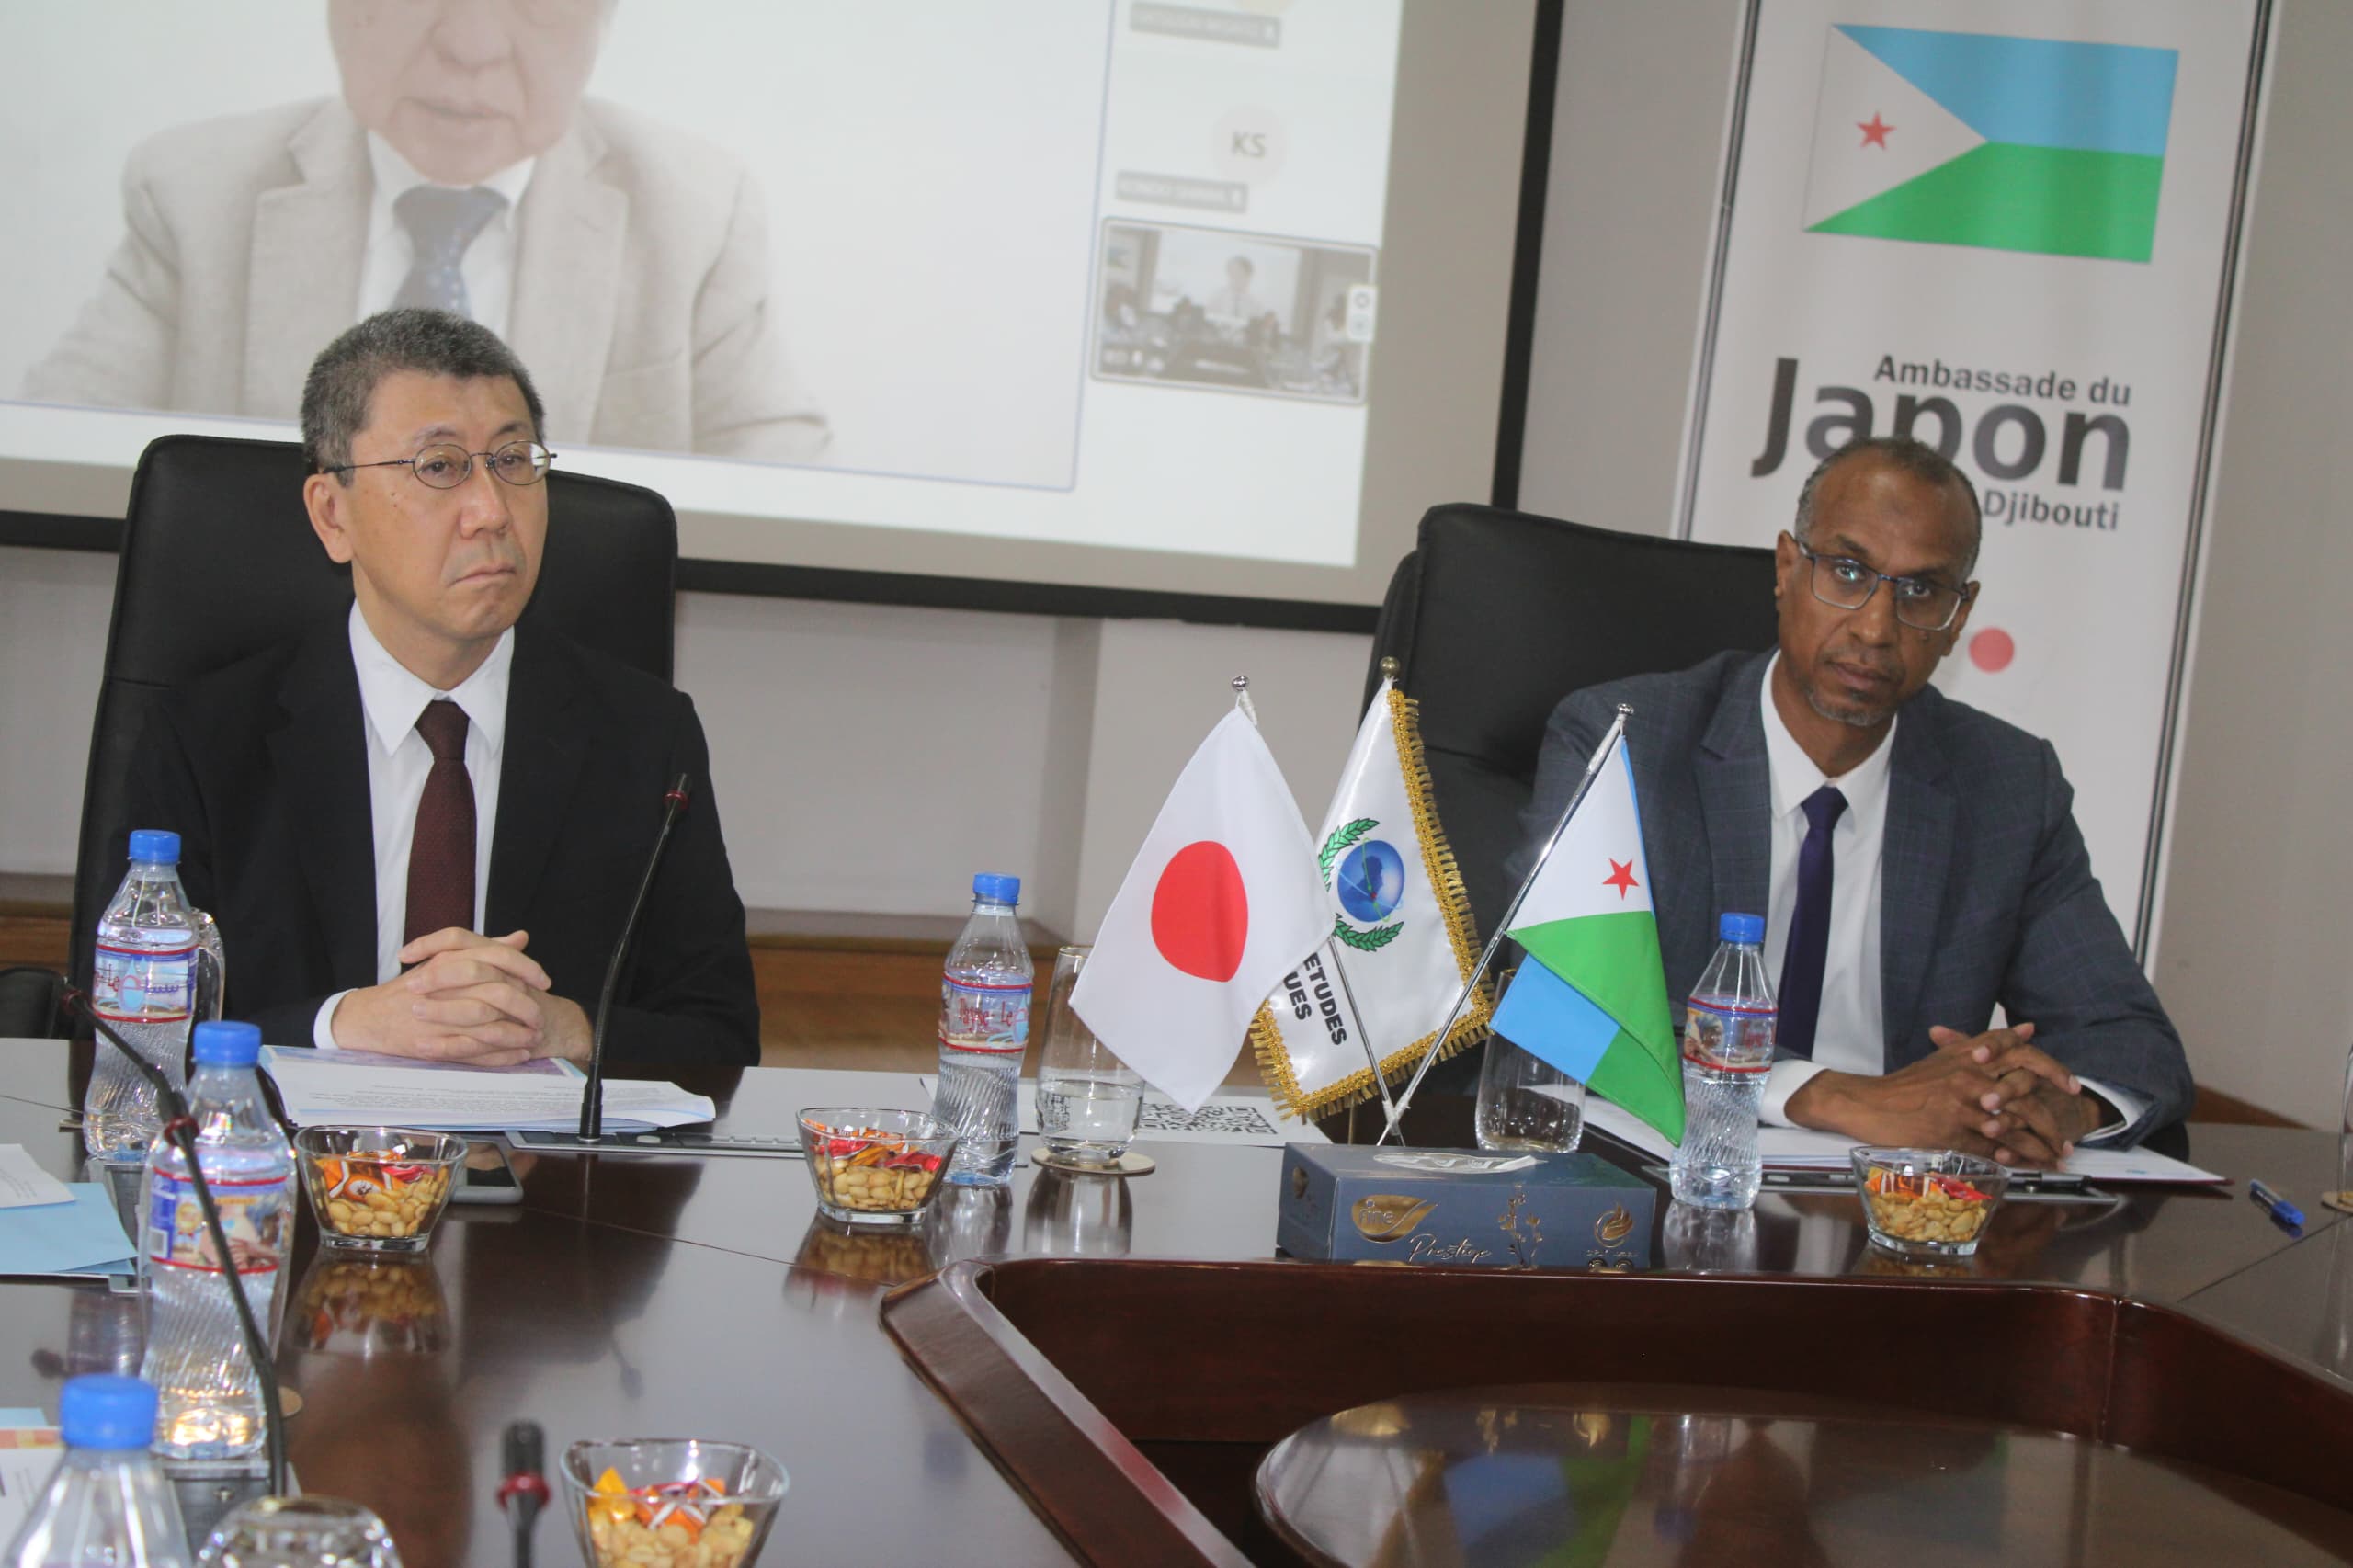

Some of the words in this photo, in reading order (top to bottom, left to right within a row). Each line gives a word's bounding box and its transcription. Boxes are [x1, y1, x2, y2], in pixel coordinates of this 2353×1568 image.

[1231, 131, 1267, 159] KS
[1874, 353, 2076, 401] Ambassade
[2089, 377, 2131, 406] du
[1984, 489, 2119, 530] Djibouti
[1303, 952, 1347, 1045] ETUDES
[1358, 1199, 1394, 1226] fine
